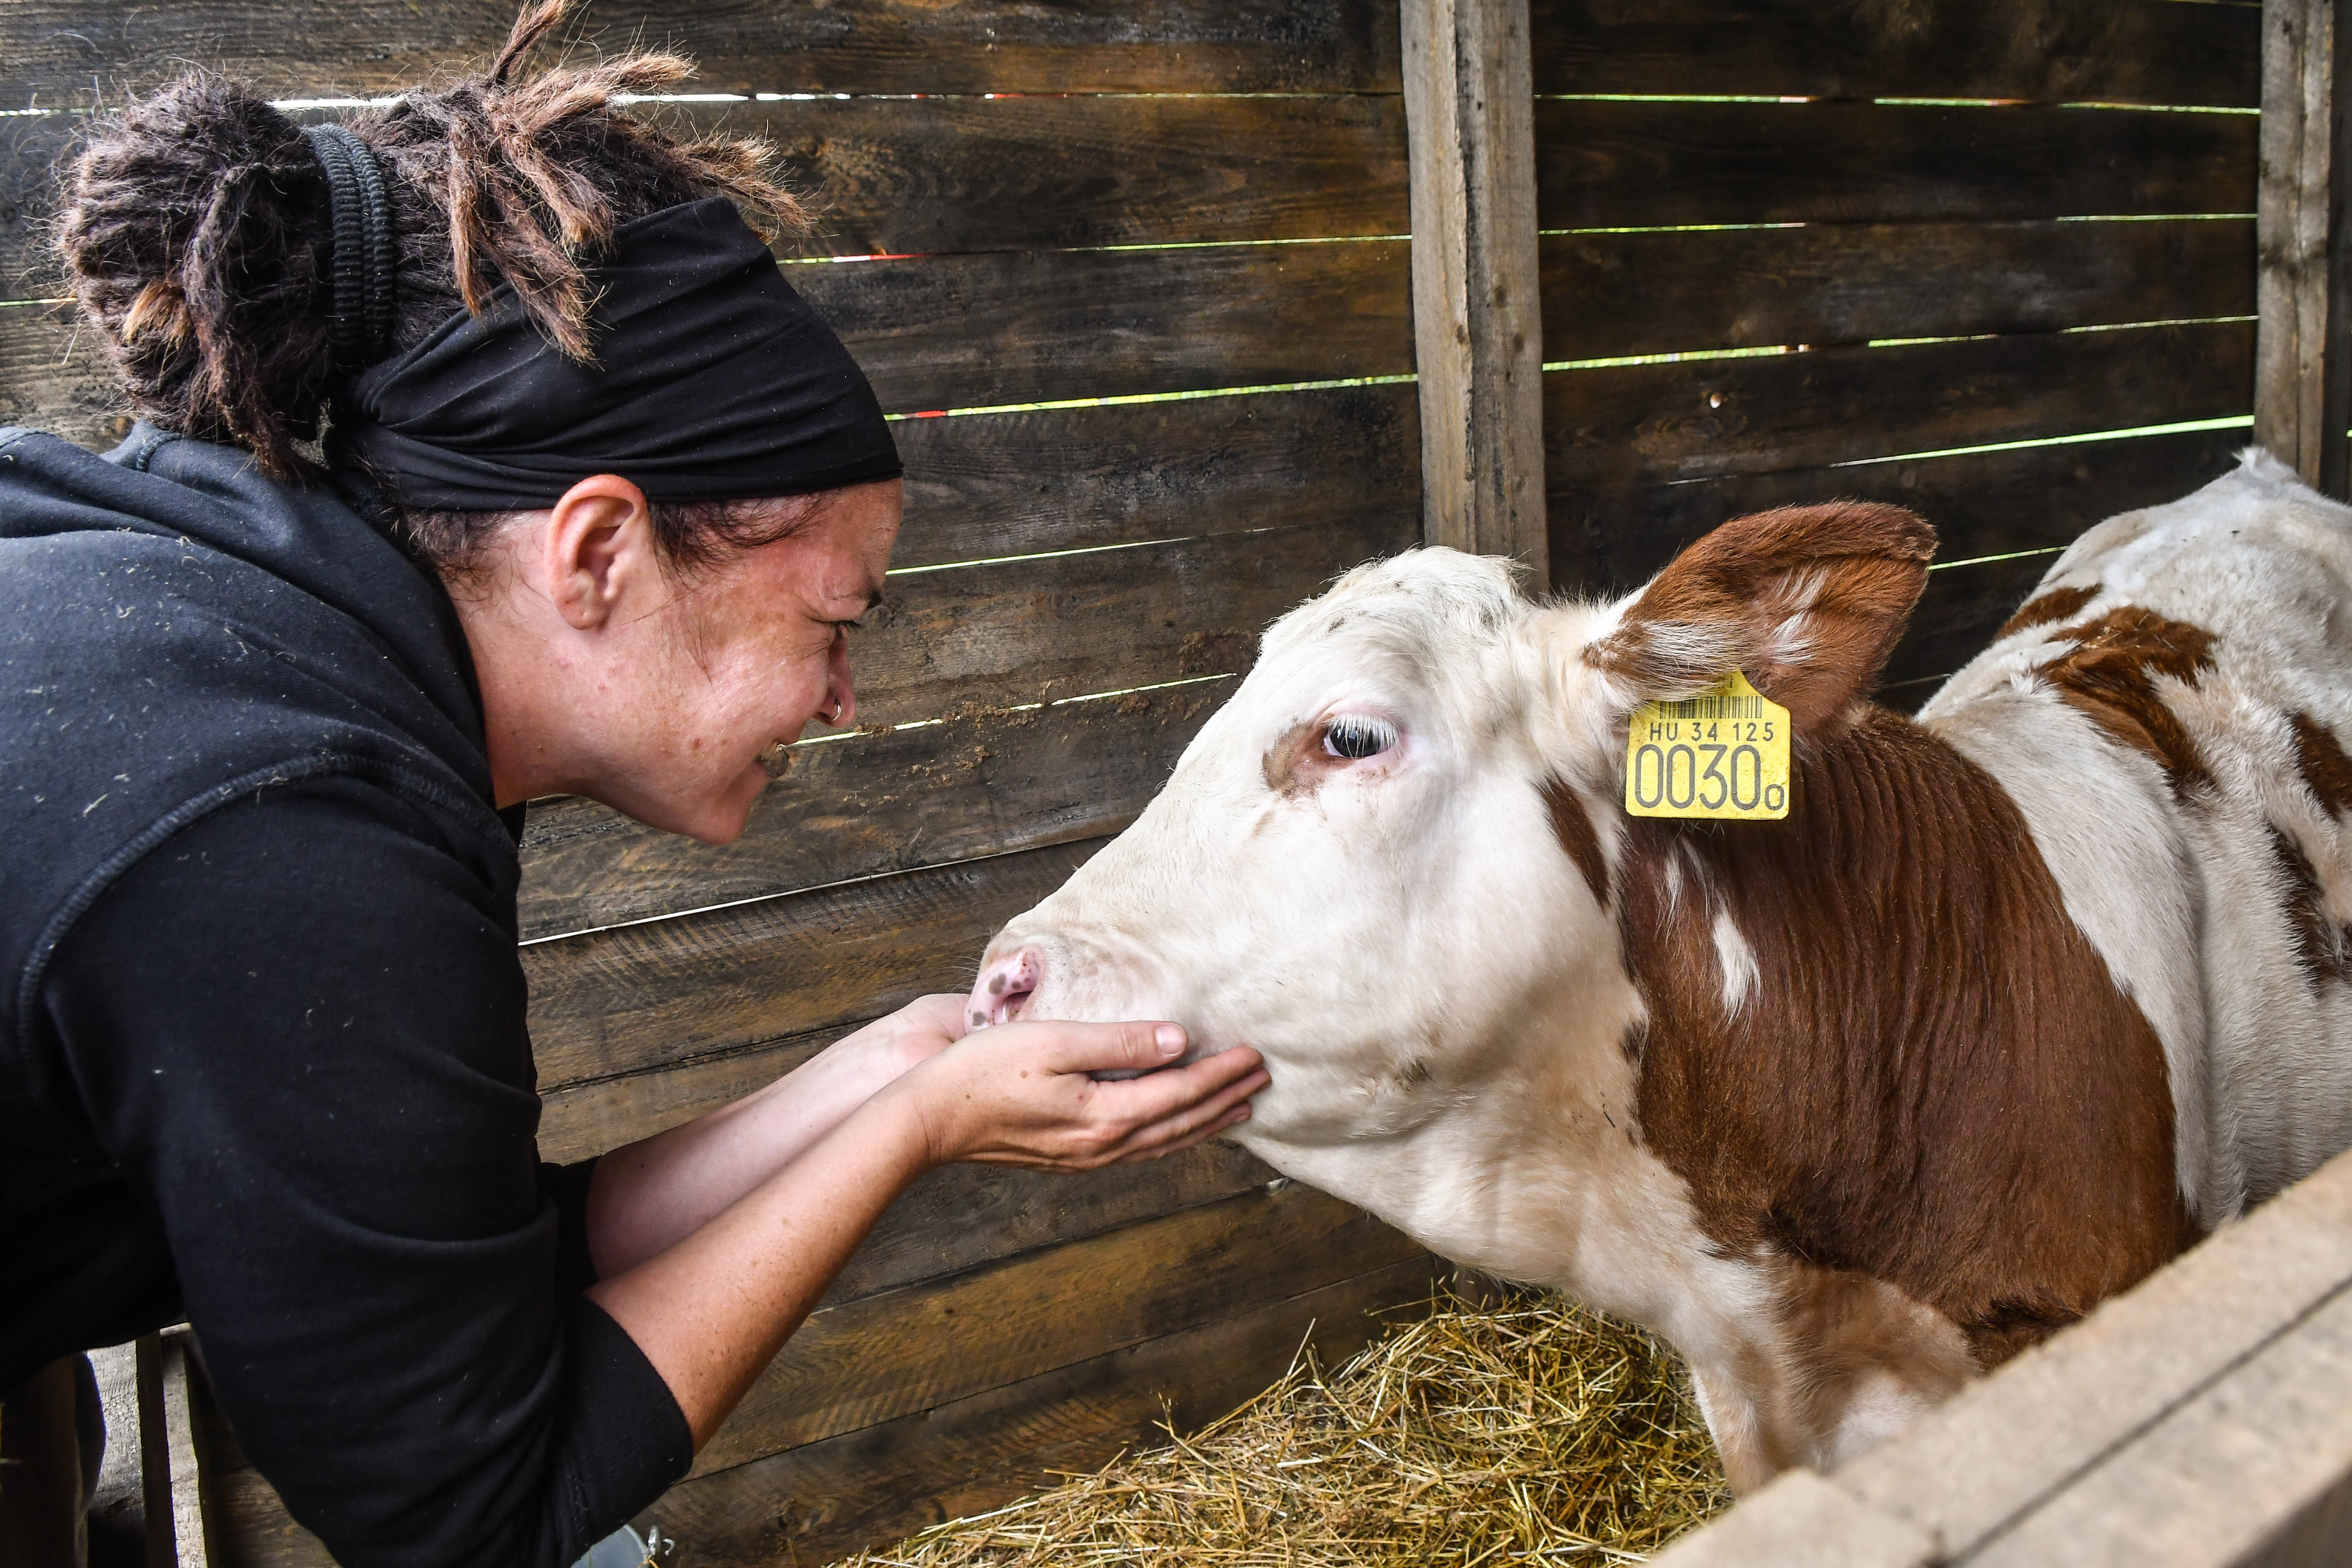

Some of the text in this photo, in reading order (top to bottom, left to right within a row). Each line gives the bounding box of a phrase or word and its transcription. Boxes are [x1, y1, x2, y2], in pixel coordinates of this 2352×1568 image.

[1650, 722, 1774, 742] HU 34 125
